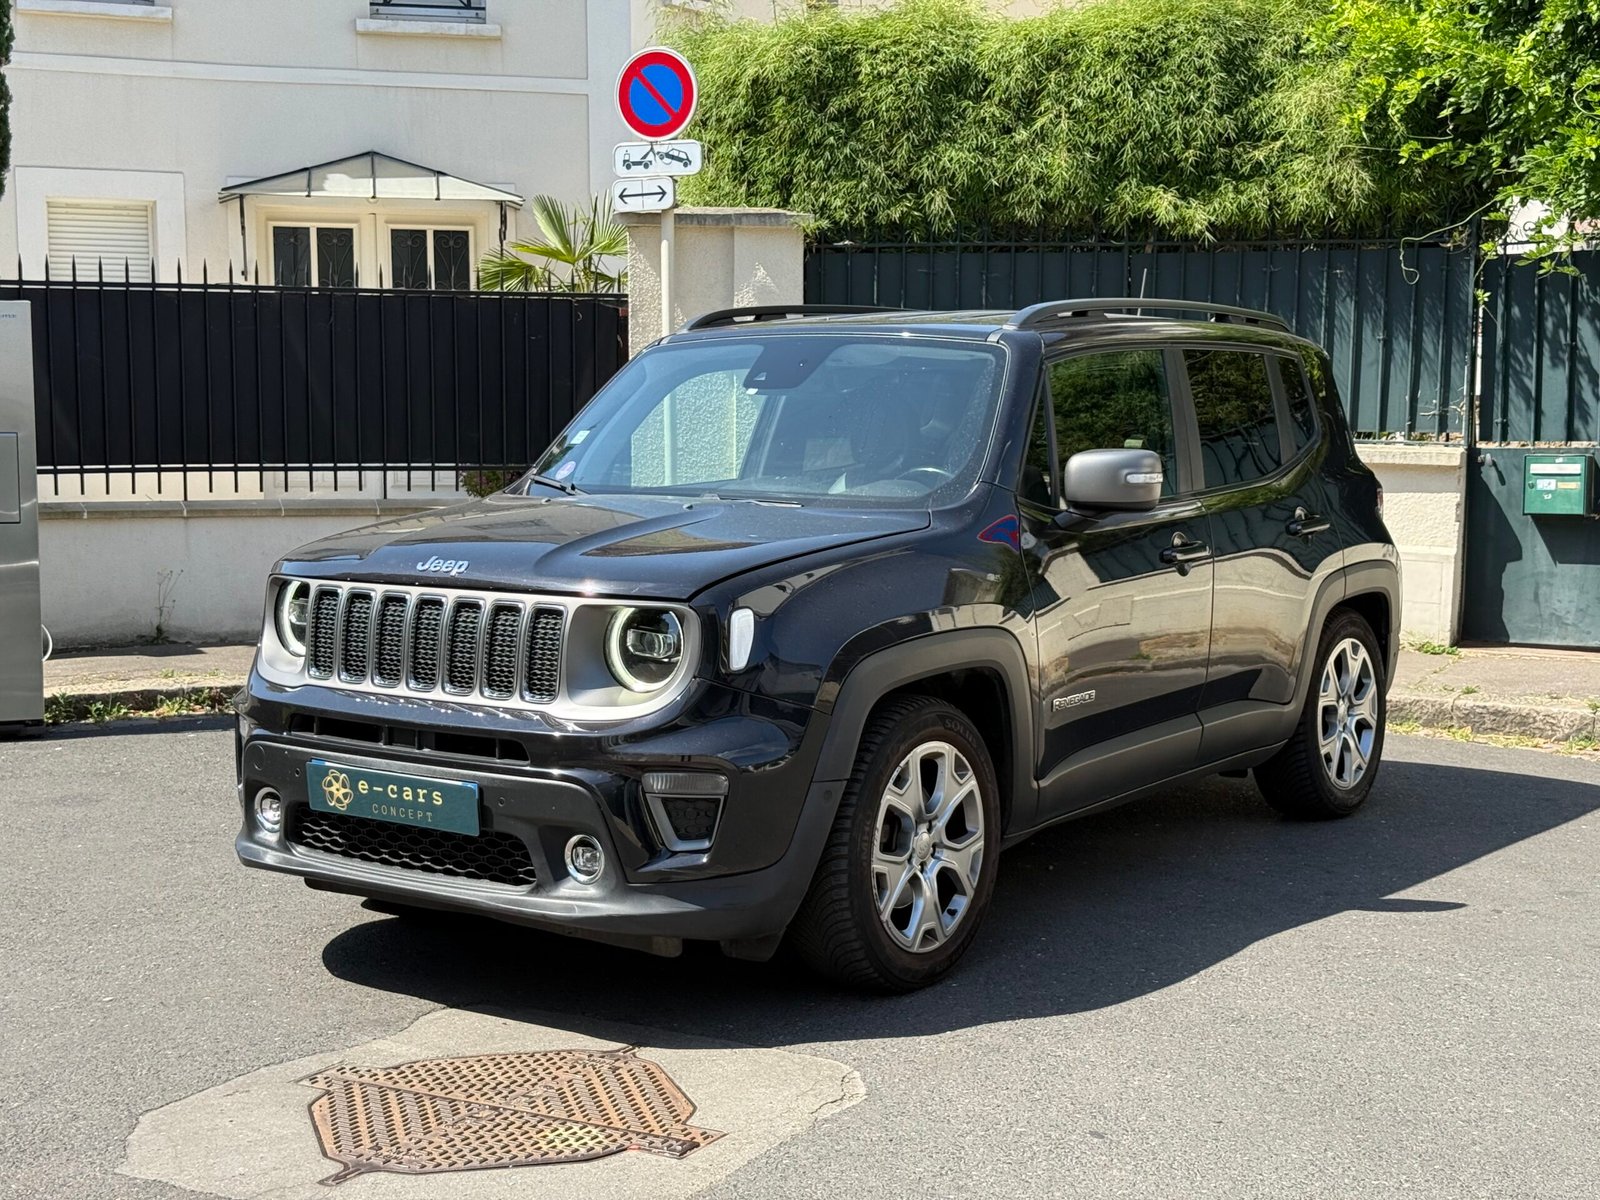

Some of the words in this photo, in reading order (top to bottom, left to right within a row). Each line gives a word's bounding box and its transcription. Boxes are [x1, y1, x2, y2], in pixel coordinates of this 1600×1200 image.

[416, 555, 469, 576] Jeep
[1053, 689, 1096, 712] RENEGADE
[357, 779, 444, 806] e-cars
[371, 803, 433, 823] CONCEPT
